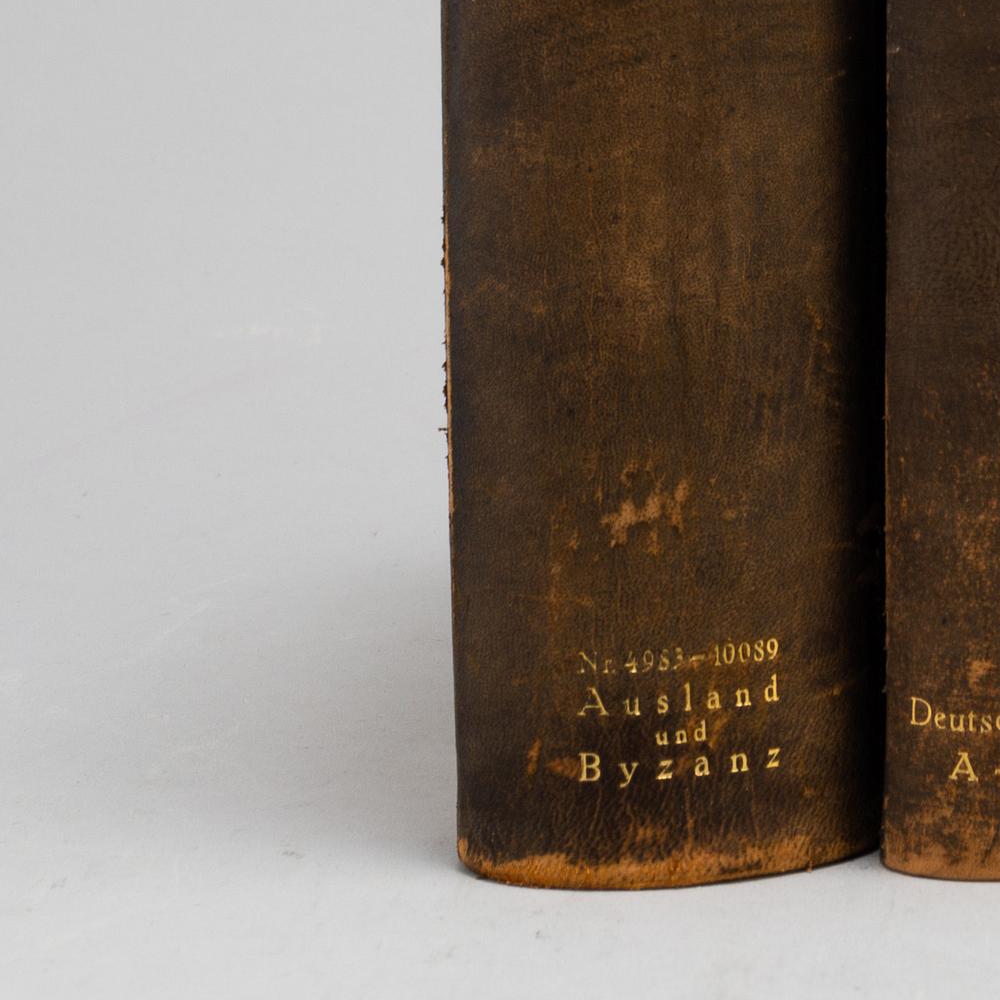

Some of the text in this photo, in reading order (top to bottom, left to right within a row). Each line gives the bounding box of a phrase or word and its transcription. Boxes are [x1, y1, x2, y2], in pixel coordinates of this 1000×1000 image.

[577, 652, 615, 674] Nr.
[577, 673, 779, 716] Ausland
[655, 720, 707, 746] und
[579, 747, 780, 788] Byzanz
[949, 751, 978, 782] A
